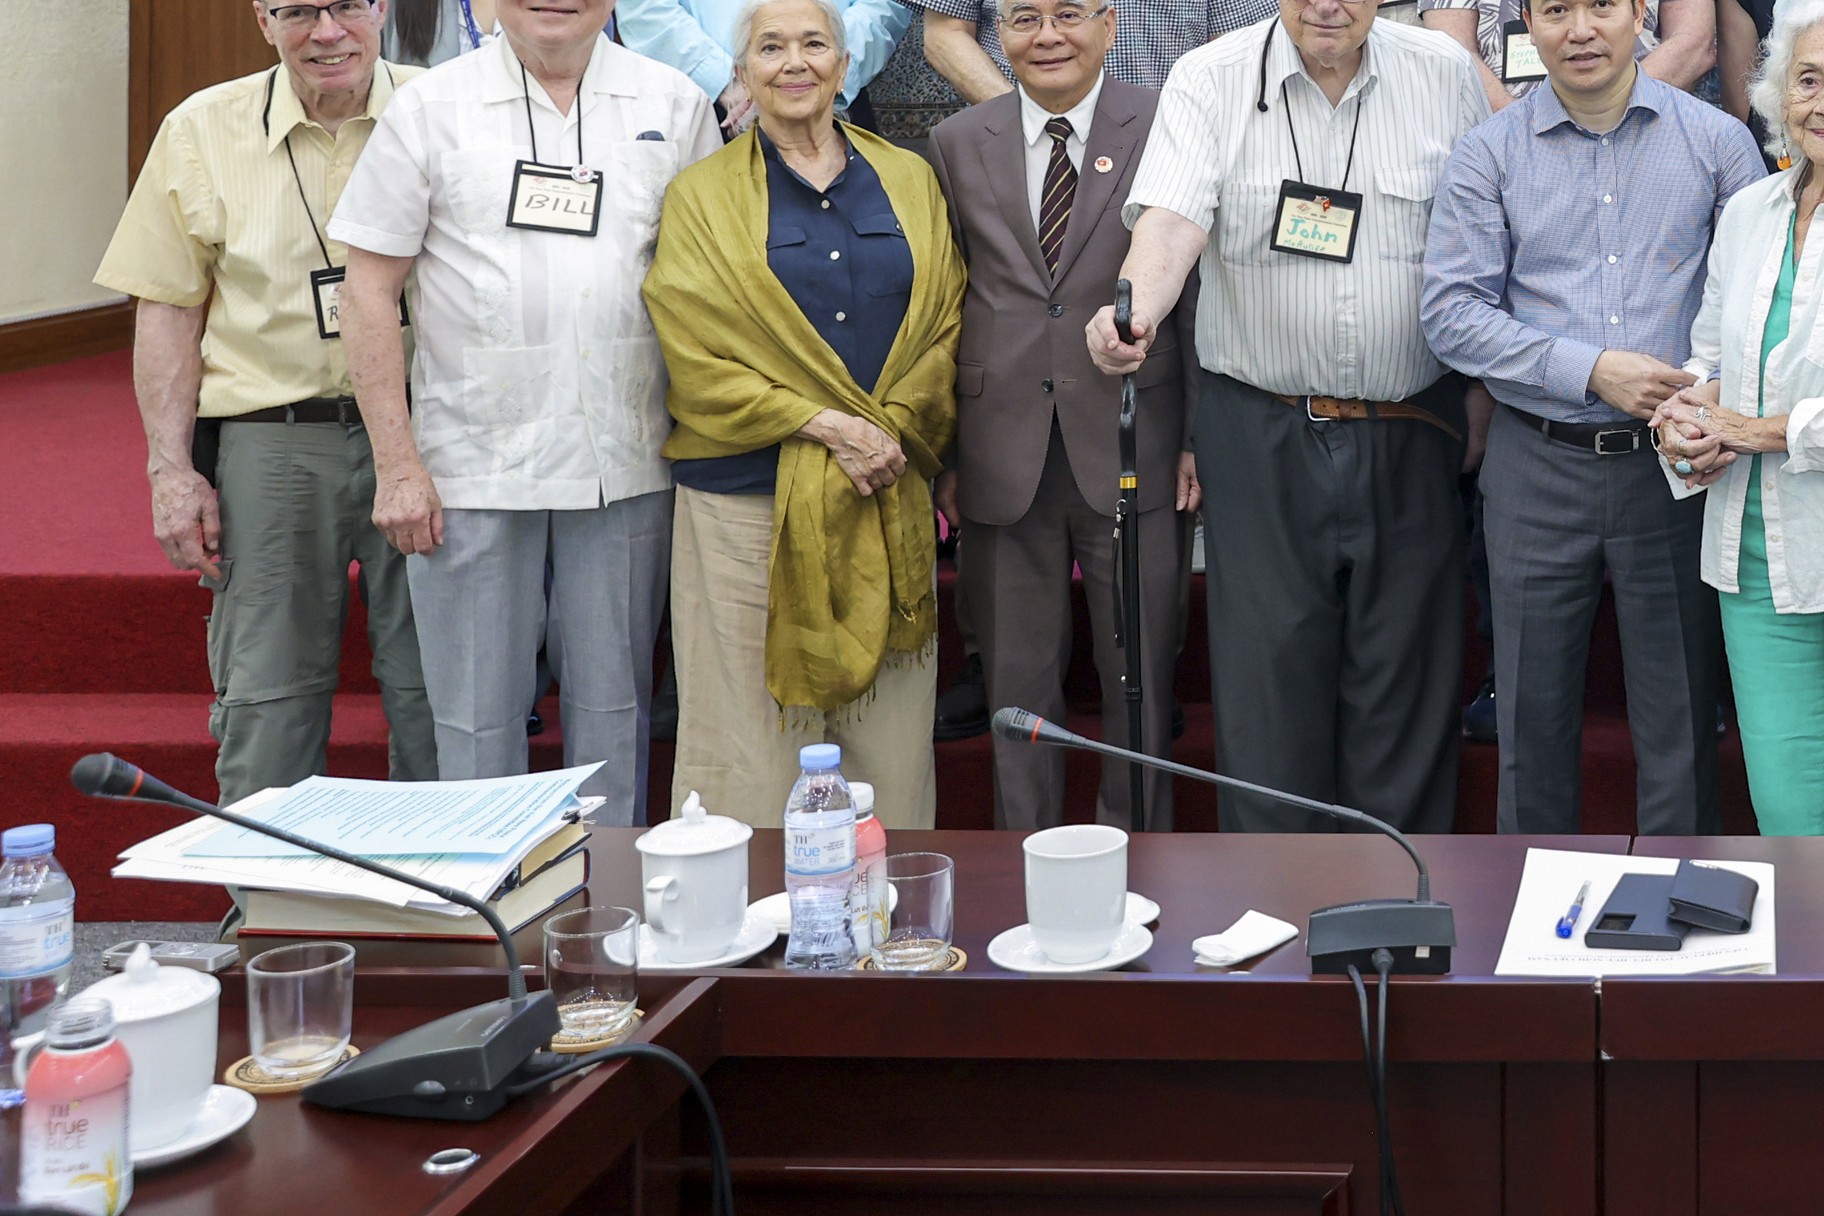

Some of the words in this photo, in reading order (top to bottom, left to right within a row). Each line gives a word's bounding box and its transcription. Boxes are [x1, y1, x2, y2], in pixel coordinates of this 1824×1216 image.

[525, 193, 595, 215] BILL
[1287, 218, 1338, 244] John
[794, 835, 808, 845] TH
[794, 845, 821, 857] true
[50, 1104, 69, 1117] TH
[48, 1118, 89, 1136] true
